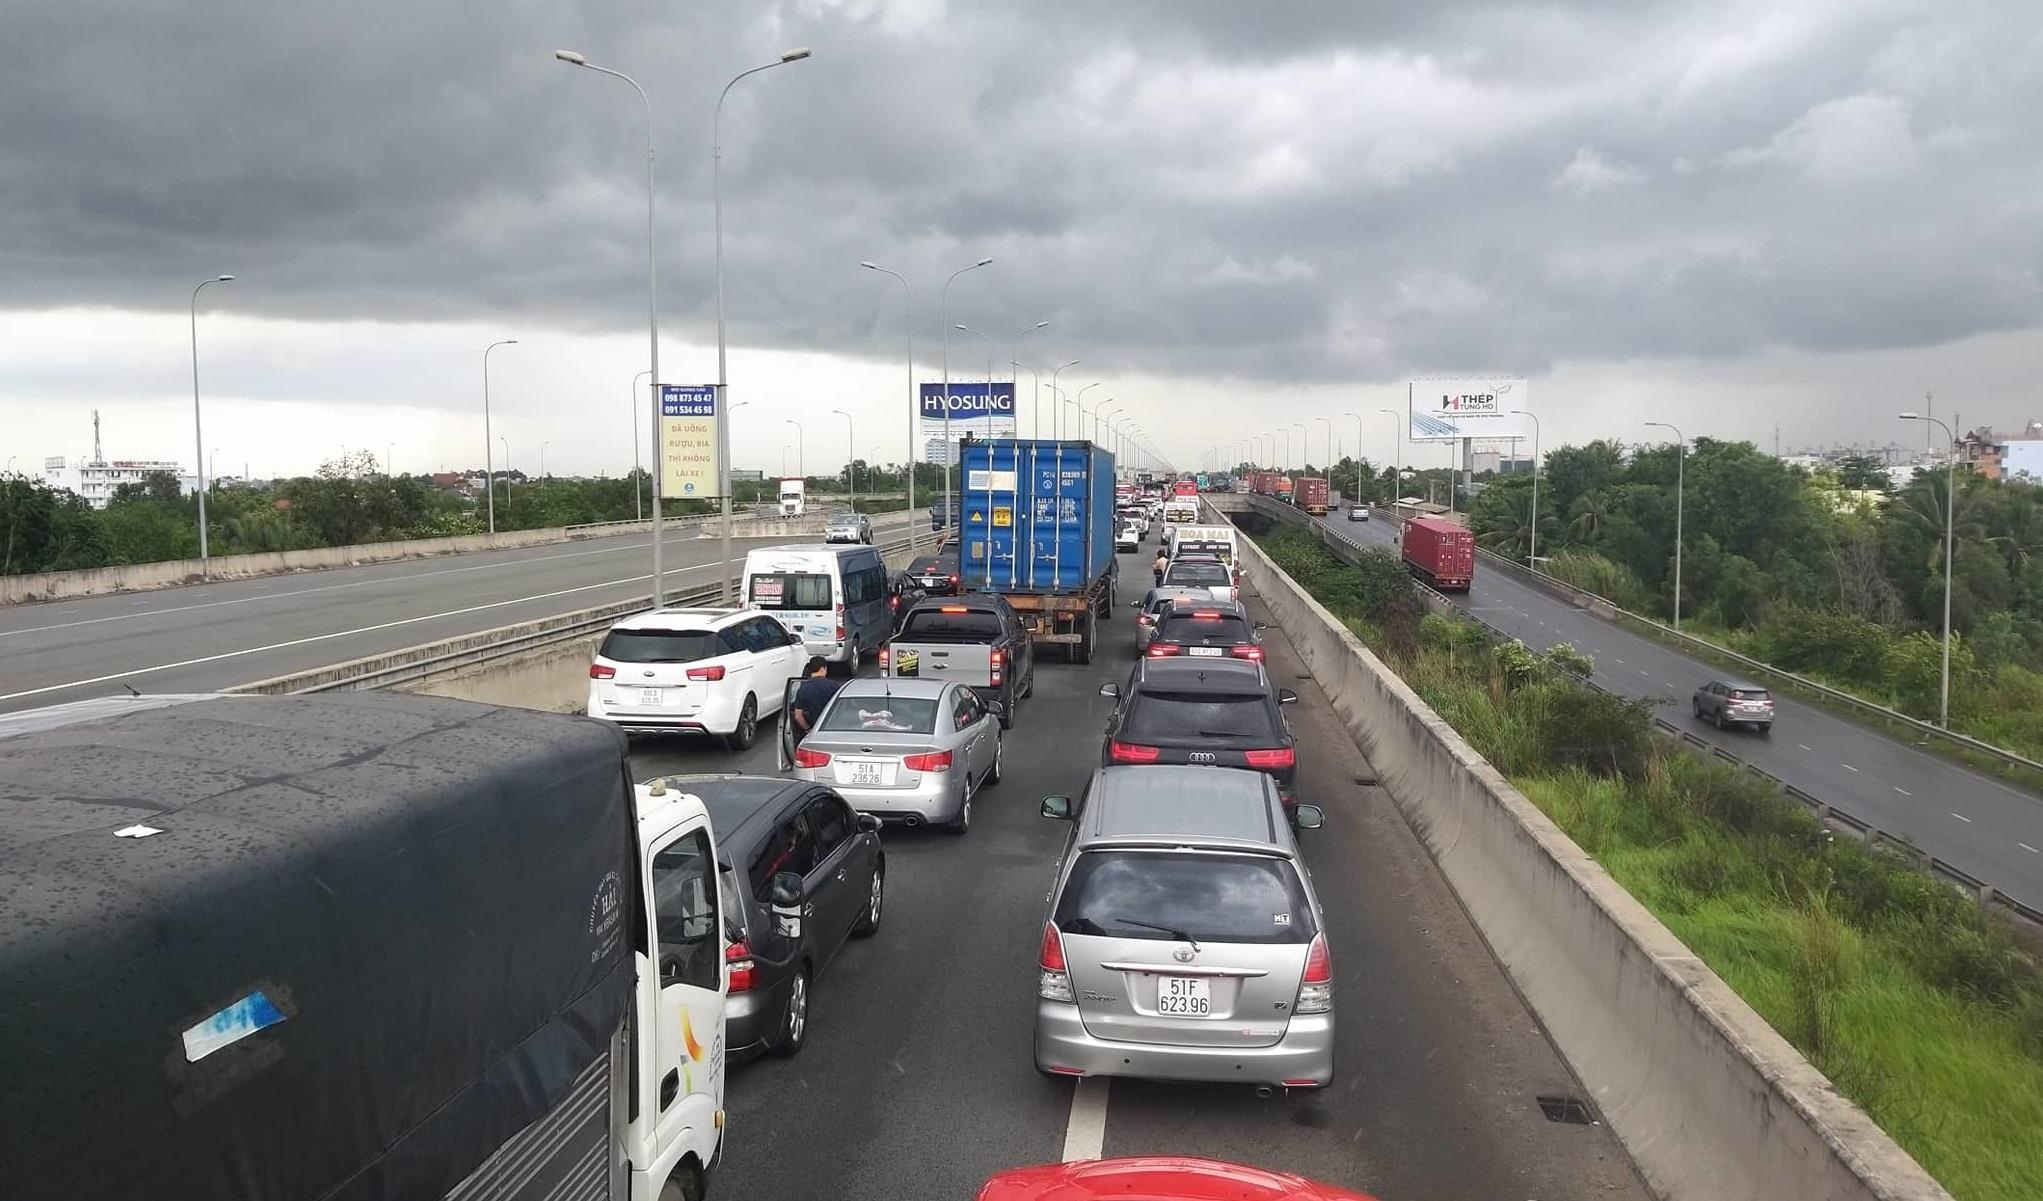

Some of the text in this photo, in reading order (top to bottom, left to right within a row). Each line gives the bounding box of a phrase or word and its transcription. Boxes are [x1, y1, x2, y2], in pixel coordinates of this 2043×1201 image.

[664, 393, 712, 402] 098 873 45 47
[924, 395, 1011, 410] HYOSUNG
[1461, 392, 1494, 403] THÉP
[665, 405, 678, 414] 091
[679, 405, 692, 414] 534
[693, 405, 702, 414] 45
[858, 763, 874, 773] 51A
[1170, 979, 1198, 996] 51F
